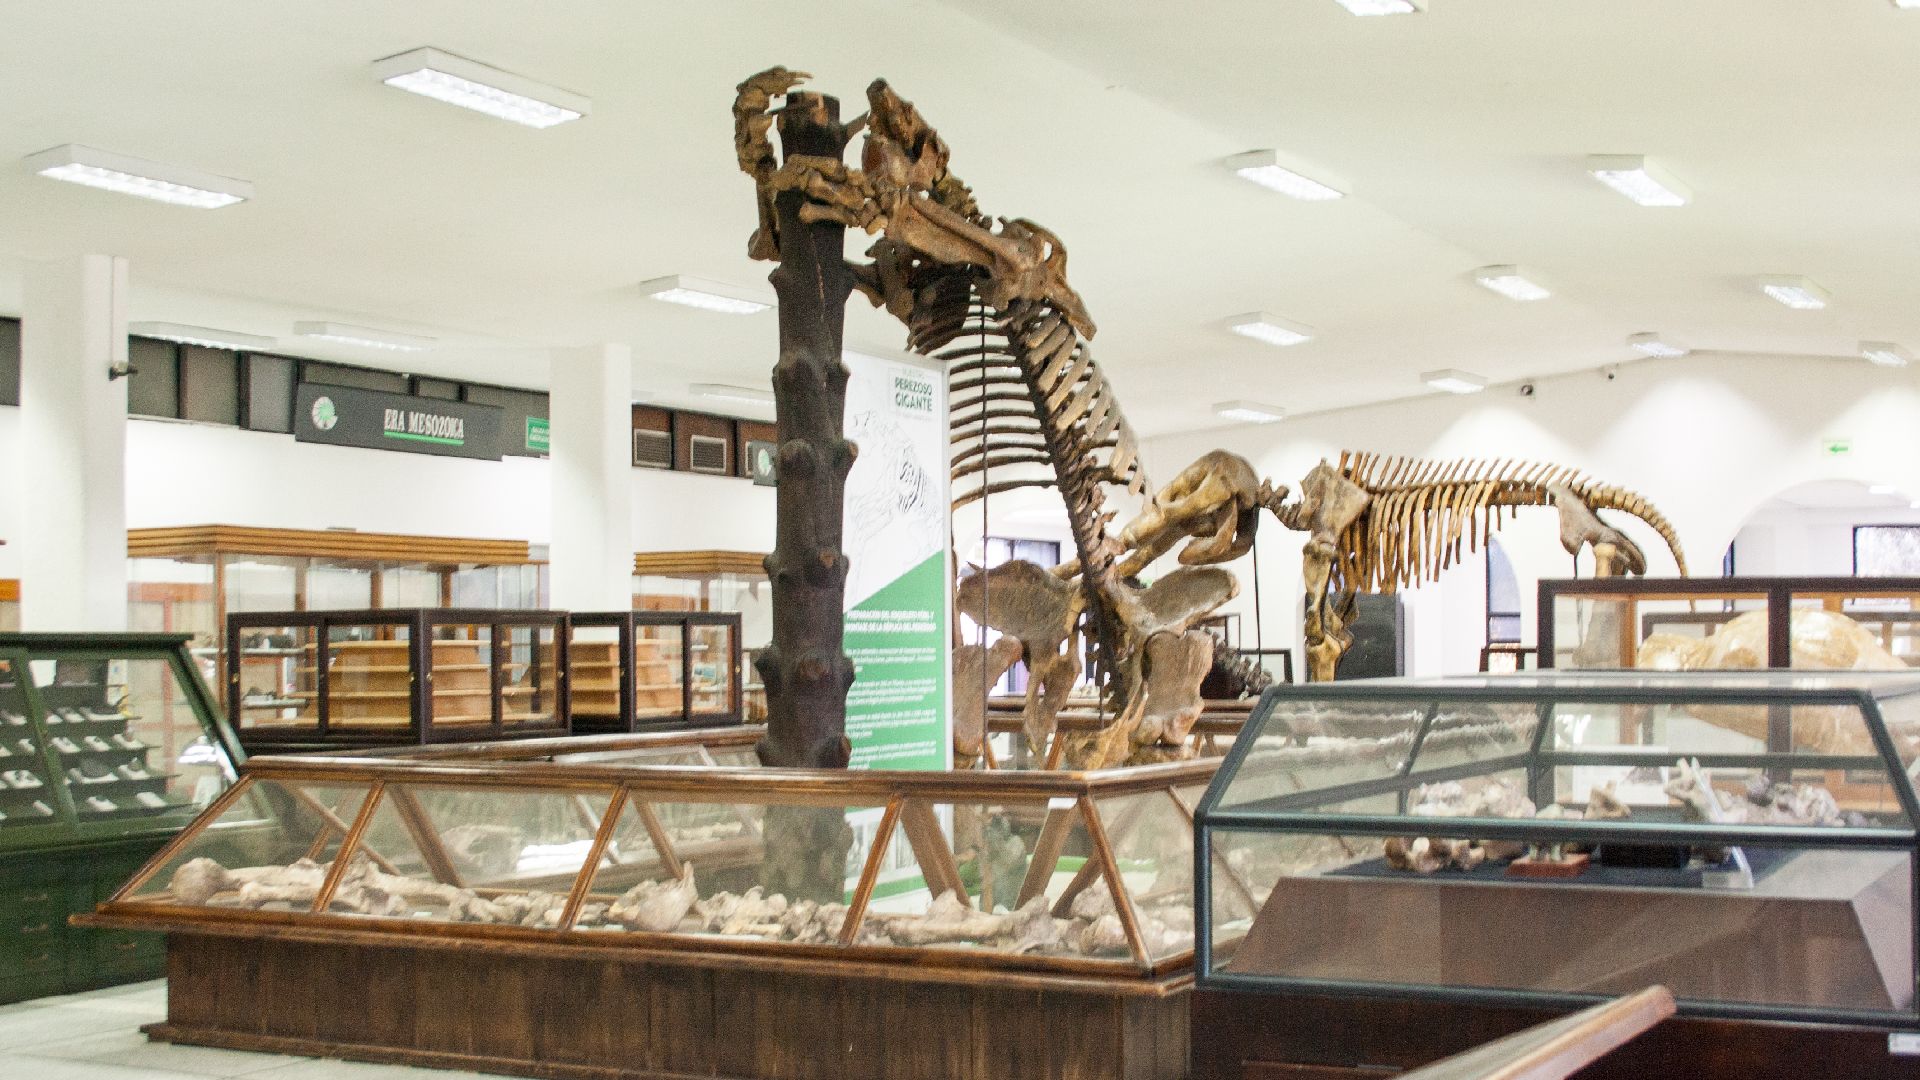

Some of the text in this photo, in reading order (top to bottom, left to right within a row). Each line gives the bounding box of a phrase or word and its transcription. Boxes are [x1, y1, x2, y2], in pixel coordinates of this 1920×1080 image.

[895, 376, 932, 396] PEREZOSO
[895, 392, 932, 411] GIGANTE
[384, 408, 464, 439] ERA MESOZOICA
